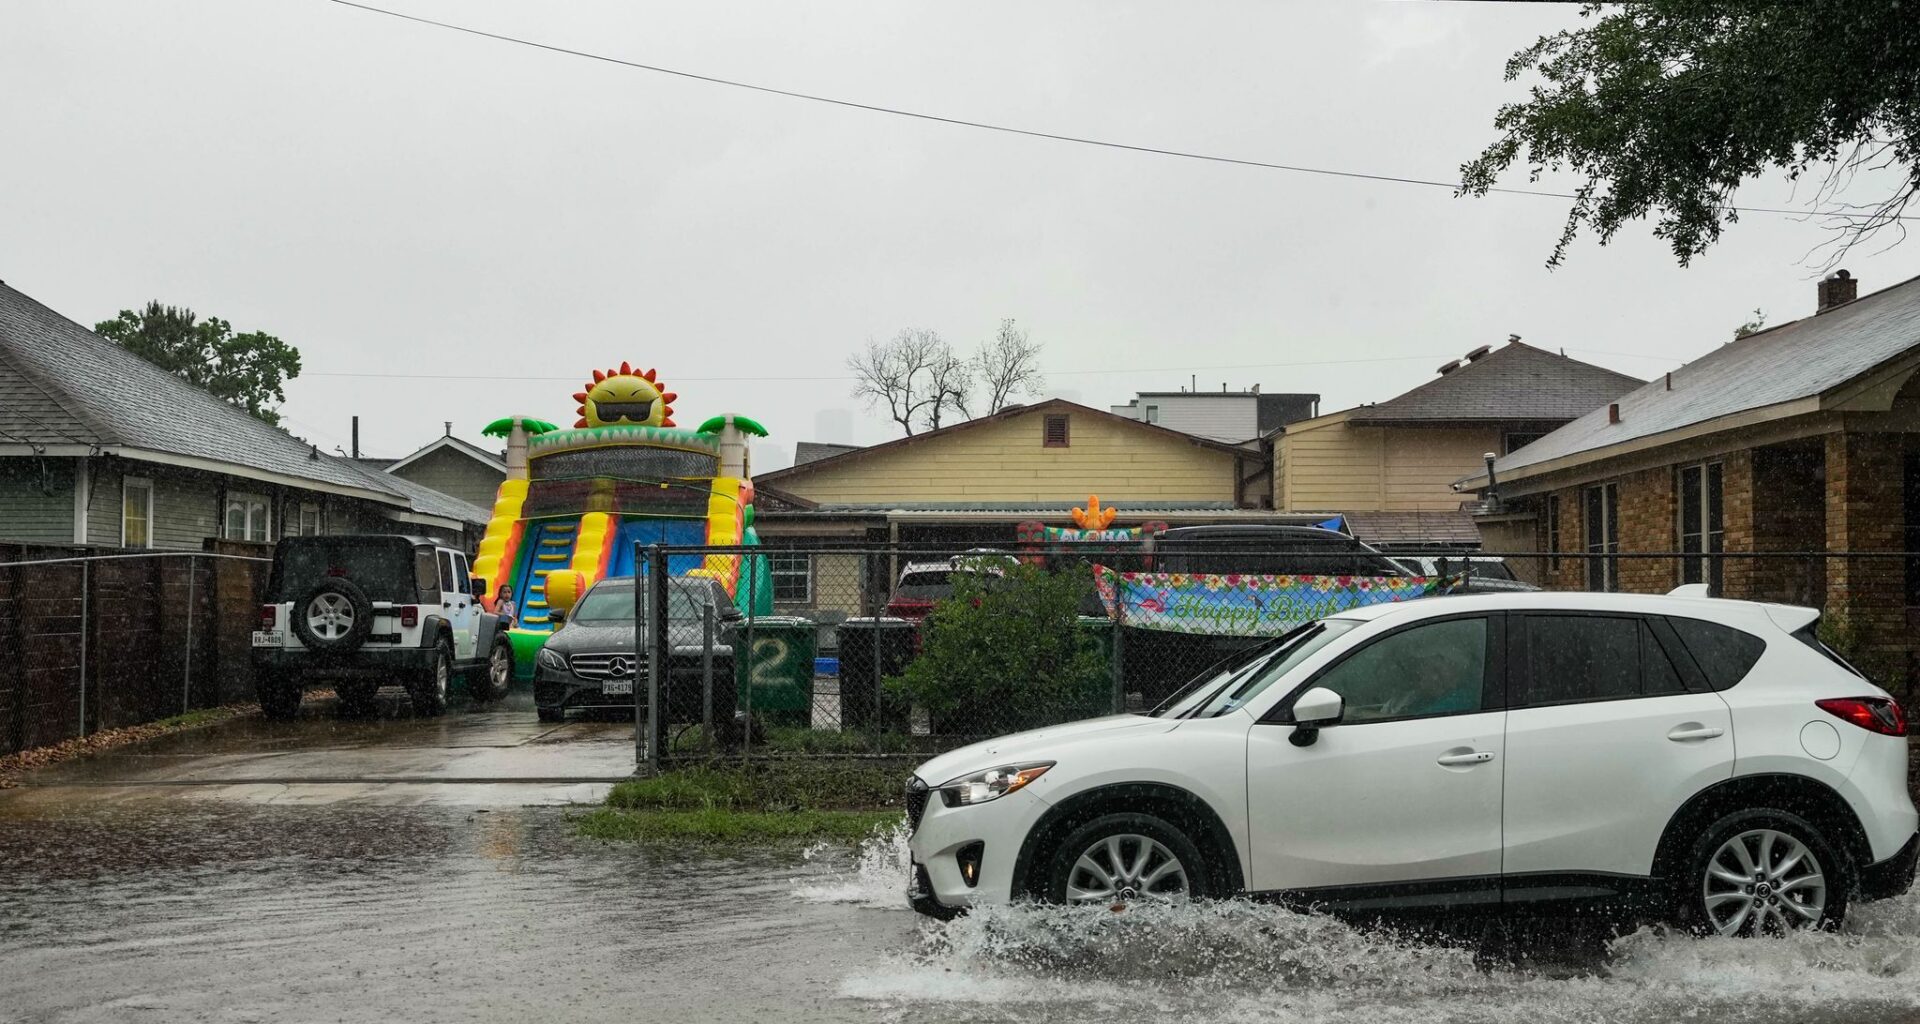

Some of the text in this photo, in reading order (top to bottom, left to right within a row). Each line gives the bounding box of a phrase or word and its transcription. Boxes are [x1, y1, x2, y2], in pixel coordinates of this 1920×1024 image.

[1060, 528, 1130, 542] ALOHA
[1174, 595, 1261, 631] Happy
[751, 638, 796, 686] 2
